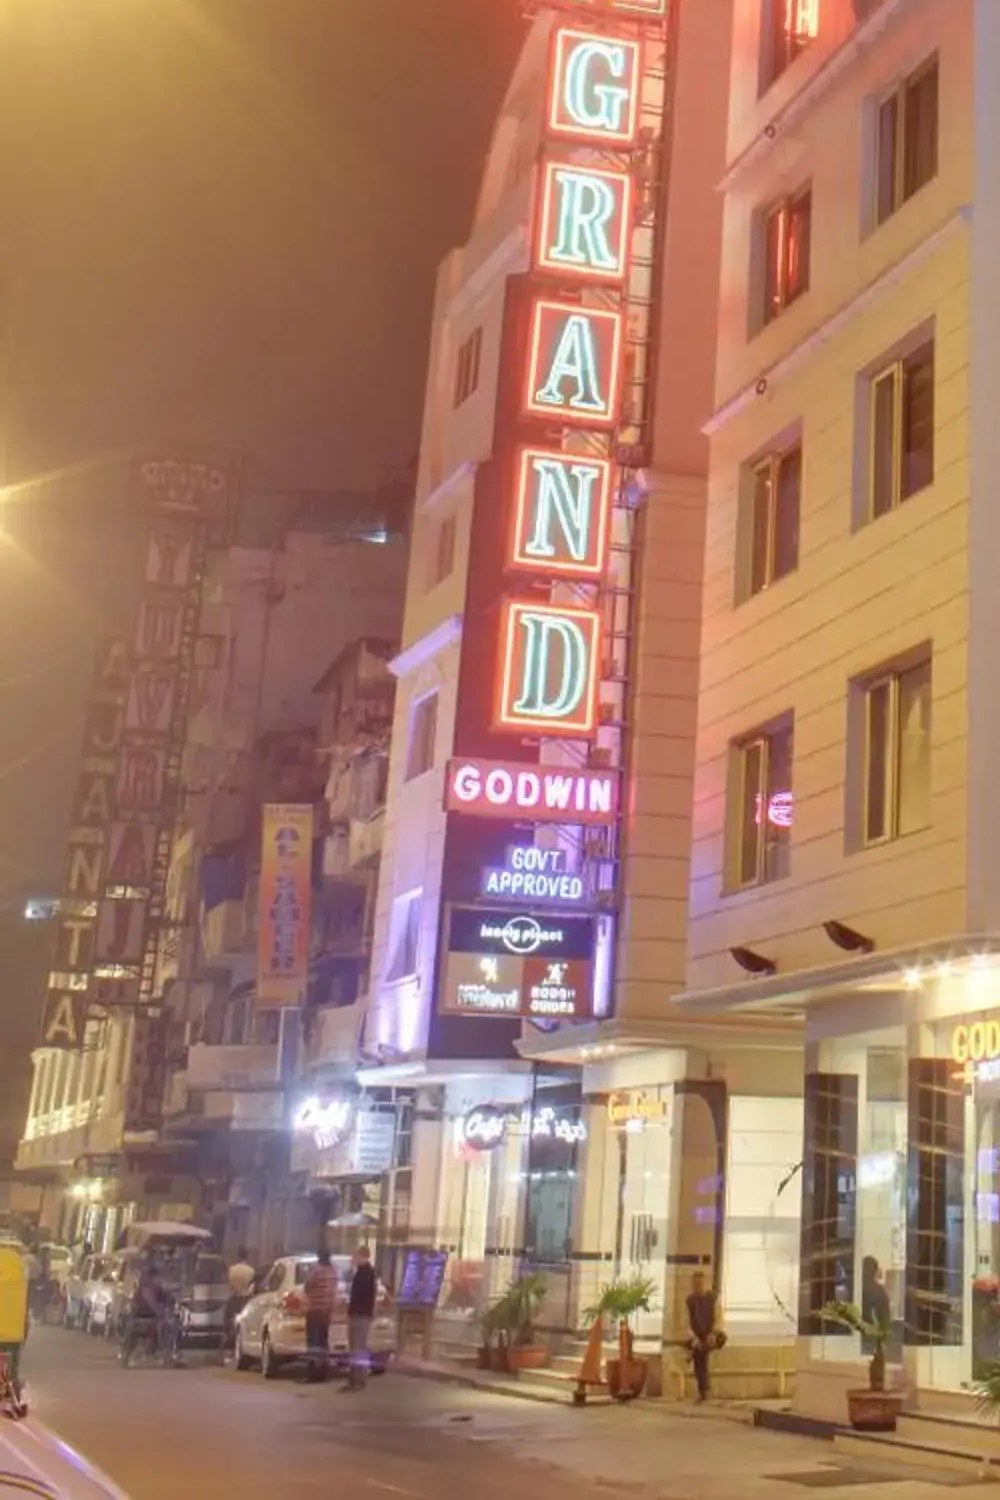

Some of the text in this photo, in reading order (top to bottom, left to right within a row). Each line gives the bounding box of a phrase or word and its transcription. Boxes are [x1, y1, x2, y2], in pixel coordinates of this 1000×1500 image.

[512, 40, 628, 718] GRAND
[454, 764, 611, 812] GODWIN
[487, 870, 583, 899] APPROVED
